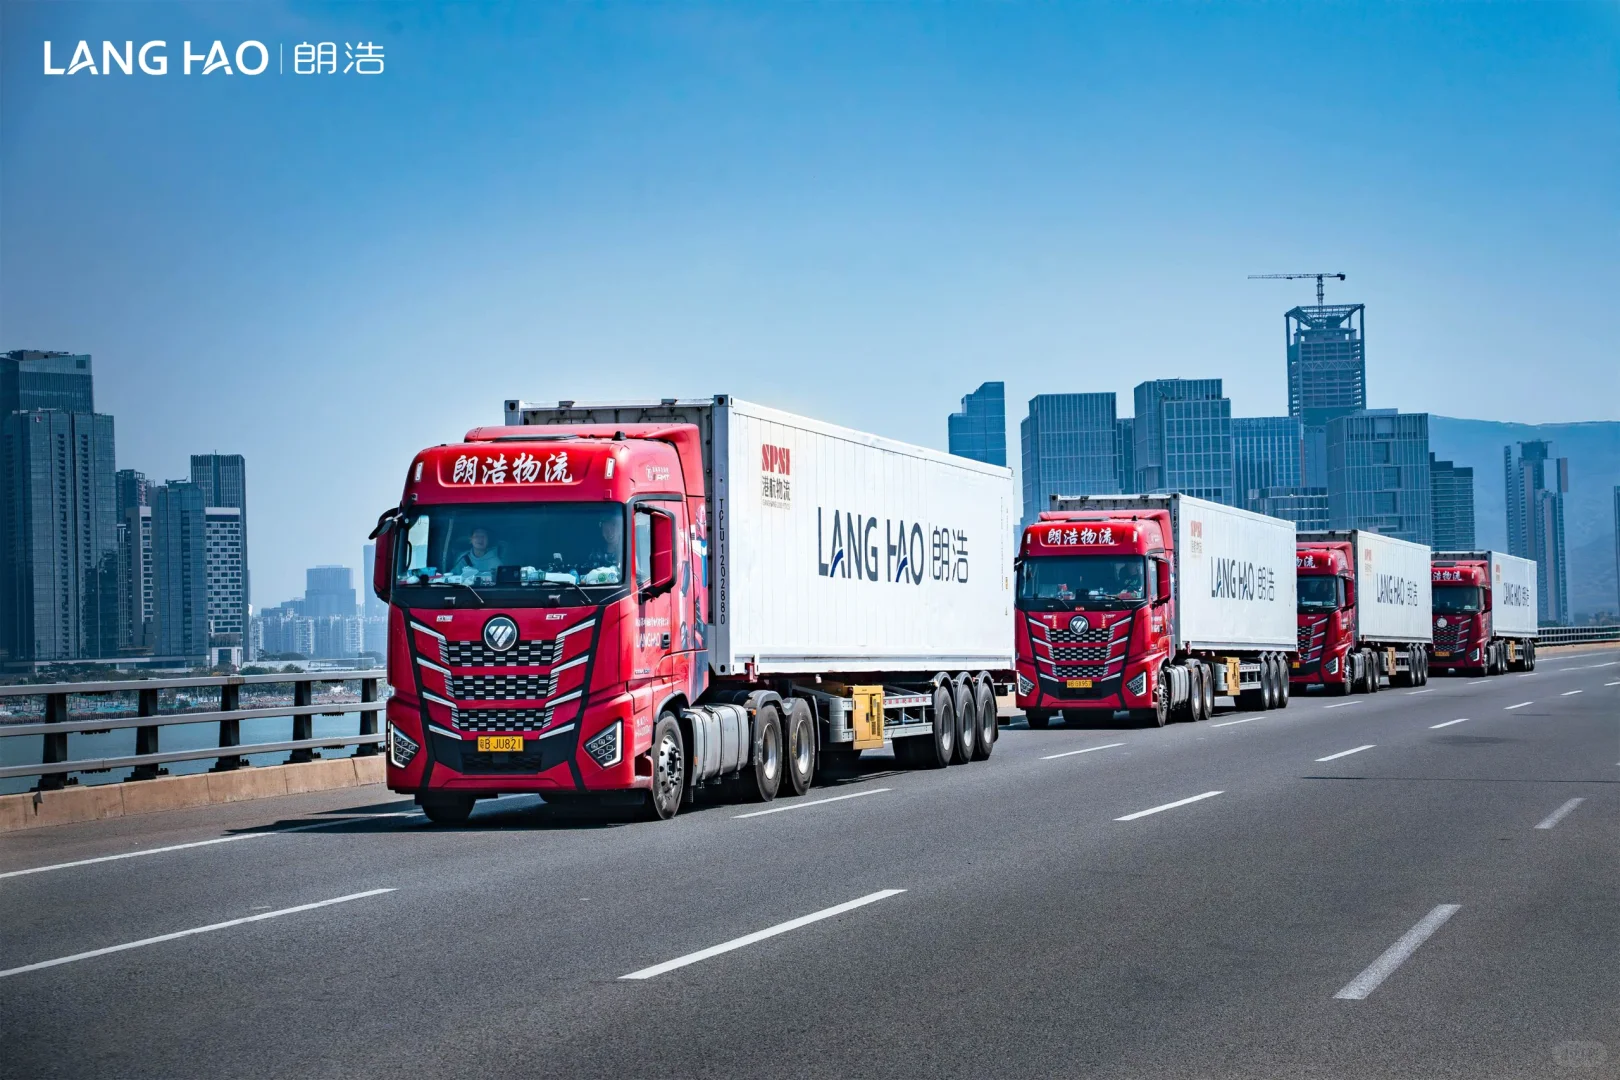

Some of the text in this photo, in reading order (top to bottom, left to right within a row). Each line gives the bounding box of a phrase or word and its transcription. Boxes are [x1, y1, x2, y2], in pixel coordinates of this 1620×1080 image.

[453, 451, 573, 485] 朗浩物流
[762, 444, 790, 475] SPSI
[818, 506, 879, 582] LANG
[886, 518, 924, 586] HAO
[932, 525, 969, 584] 朗浩
[1048, 527, 1115, 545] 朗浩物流
[1211, 556, 1254, 601] LANG HAO
